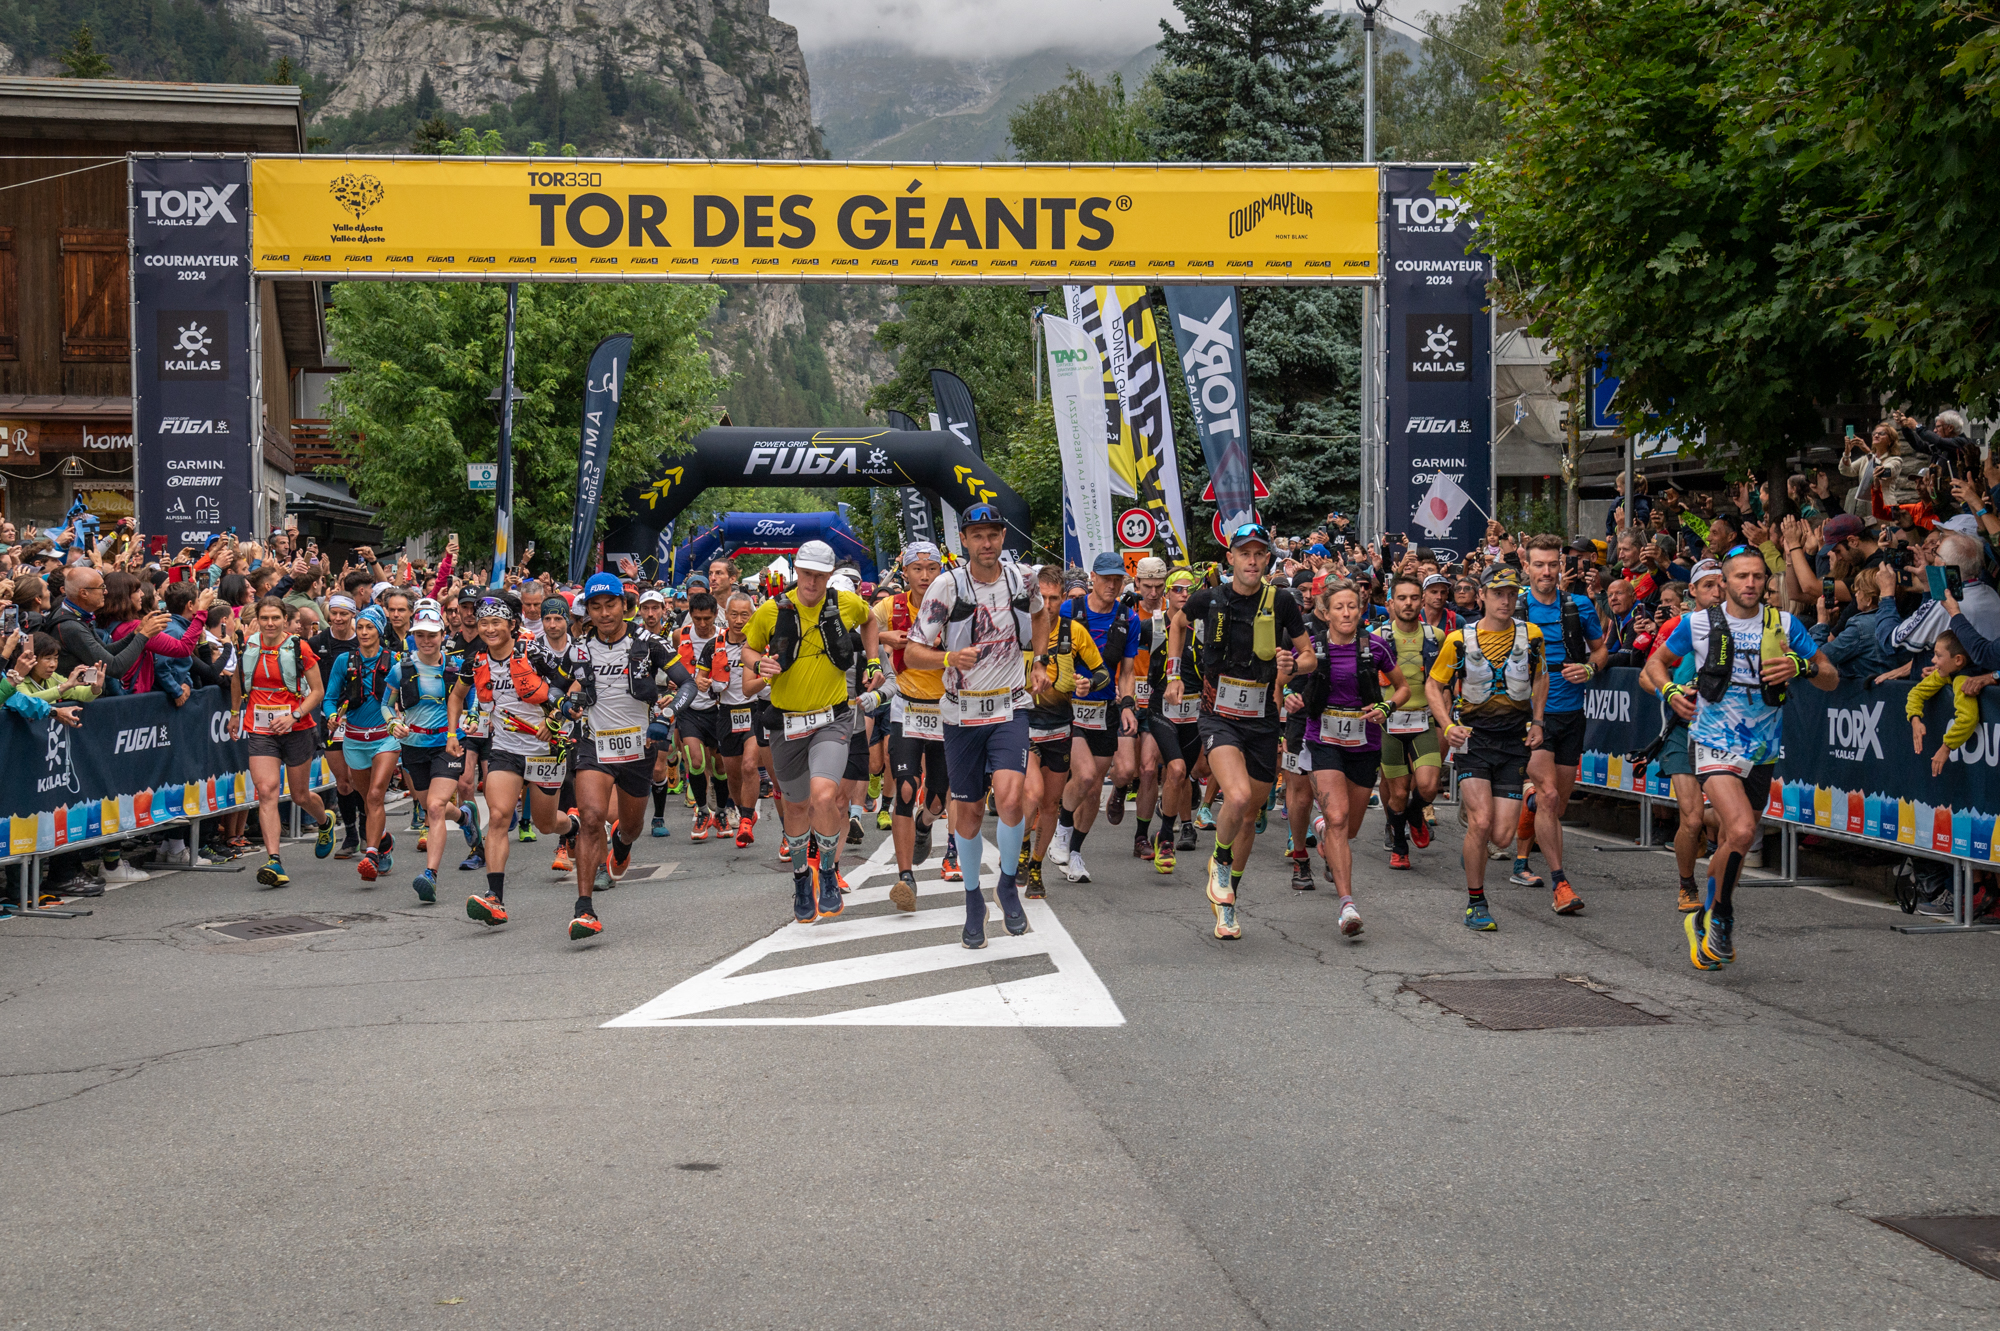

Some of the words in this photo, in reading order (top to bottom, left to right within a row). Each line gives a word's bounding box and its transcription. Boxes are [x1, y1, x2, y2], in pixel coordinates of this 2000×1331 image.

[528, 172, 601, 187] TOR330
[141, 184, 240, 226] TORX
[529, 192, 672, 249] TOR
[693, 194, 816, 249] DES
[1229, 192, 1313, 239] COURMAYEUR
[333, 224, 354, 232] Valle
[144, 255, 239, 266] COURMAYEUR
[1395, 261, 1483, 271] COURMAYEUR
[177, 271, 206, 280] 2024
[1426, 276, 1453, 285] 2024
[165, 361, 221, 370] KAILAS
[1413, 362, 1465, 372] KAILAS
[158, 420, 213, 434] FUGA
[1405, 420, 1456, 433] FUGA
[167, 460, 224, 469] GARMIN
[743, 448, 857, 474] FUGA
[1412, 459, 1466, 468] GARMIN
[182, 476, 223, 486] ENERVIT
[587, 466, 600, 504] HOTELS
[753, 519, 795, 536] Ford
[1126, 519, 1147, 538] 30
[181, 532, 211, 541] CAAT
[590, 584, 610, 593] FUGA
[1239, 690, 1248, 703] 5
[979, 699, 994, 712] 10
[1179, 702, 1190, 713] 16
[268, 713, 274, 721] 9
[733, 713, 751, 724] 604
[1077, 708, 1097, 719] 522
[1405, 714, 1411, 723] 7
[802, 714, 817, 726] 19
[915, 716, 938, 728] 393
[1337, 720, 1351, 733] 14
[1827, 701, 1885, 762] TORX
[114, 726, 157, 754] FUGA
[609, 736, 632, 750] 606
[1286, 757, 1296, 767] 15
[537, 765, 557, 776] 624
